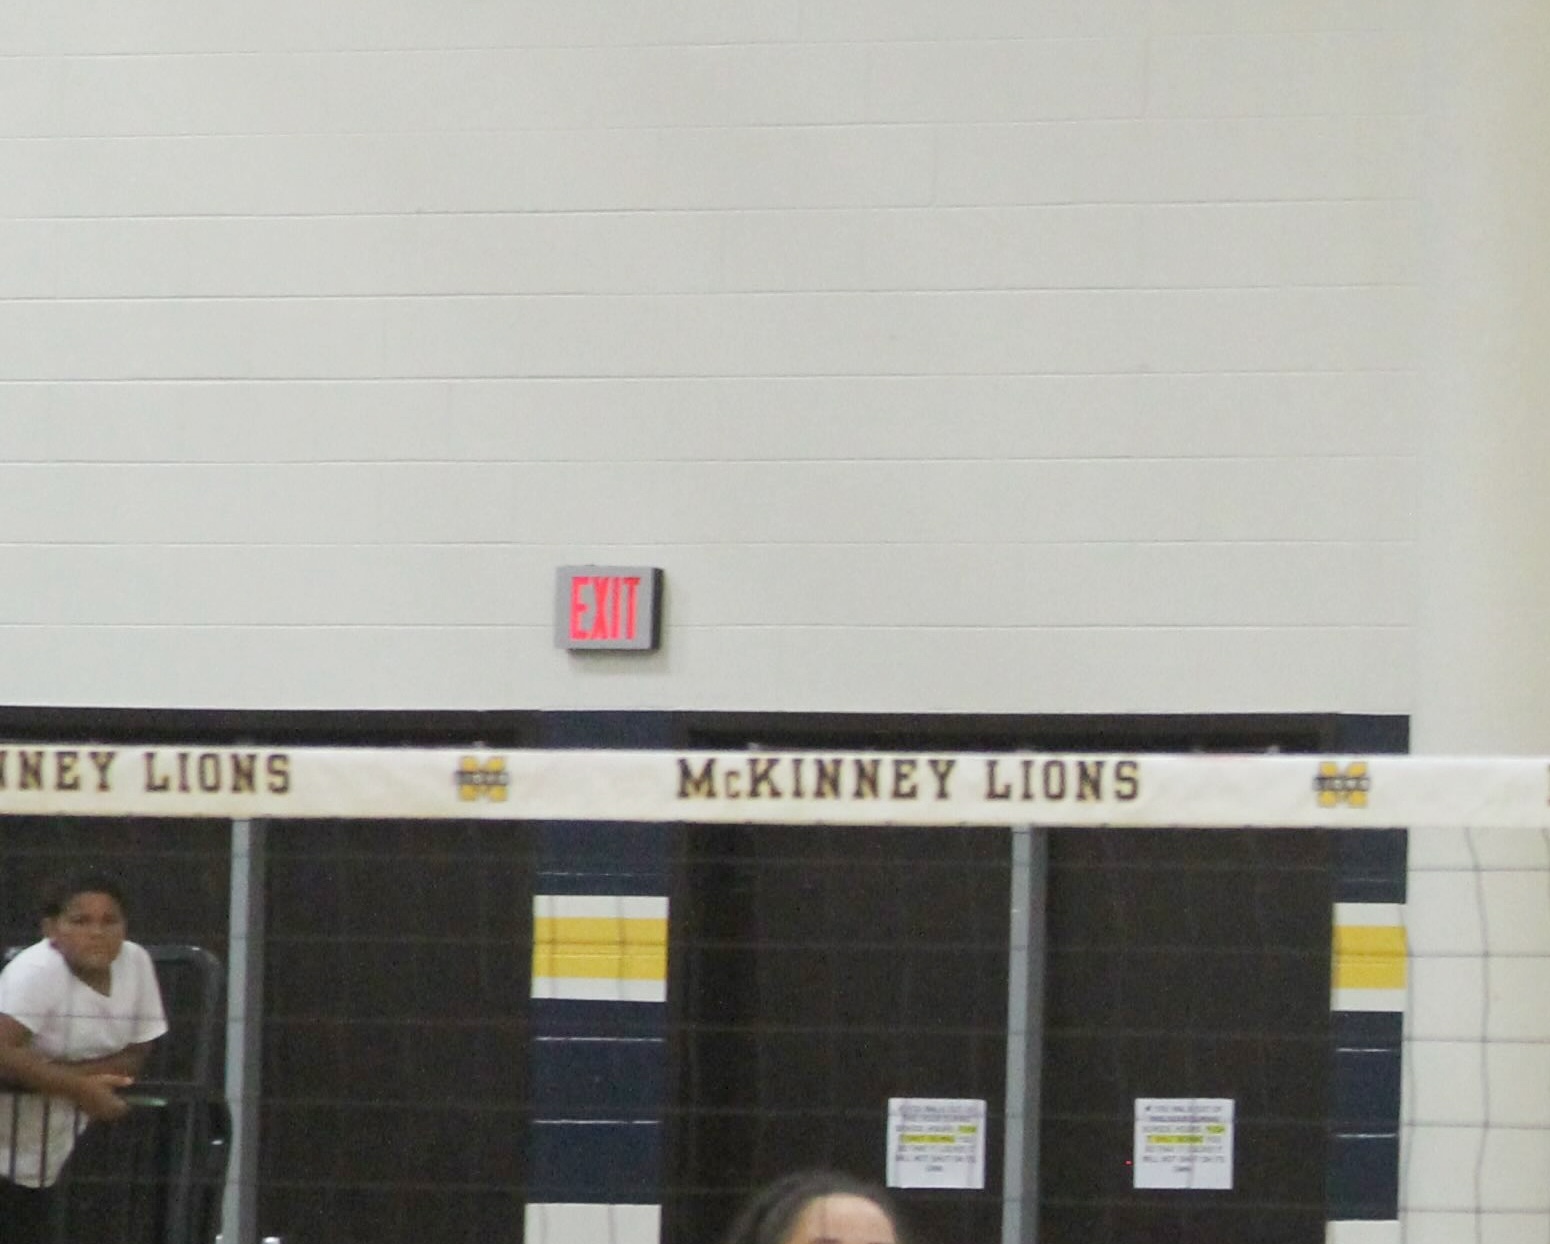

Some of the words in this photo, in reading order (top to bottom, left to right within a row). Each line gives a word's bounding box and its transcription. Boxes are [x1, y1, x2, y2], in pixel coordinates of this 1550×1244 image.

[569, 576, 641, 640] EXIT
[0, 750, 116, 791] NEY
[143, 751, 291, 793] LIONS
[677, 757, 956, 801] McKINNEY
[985, 760, 1140, 802] LIONS
